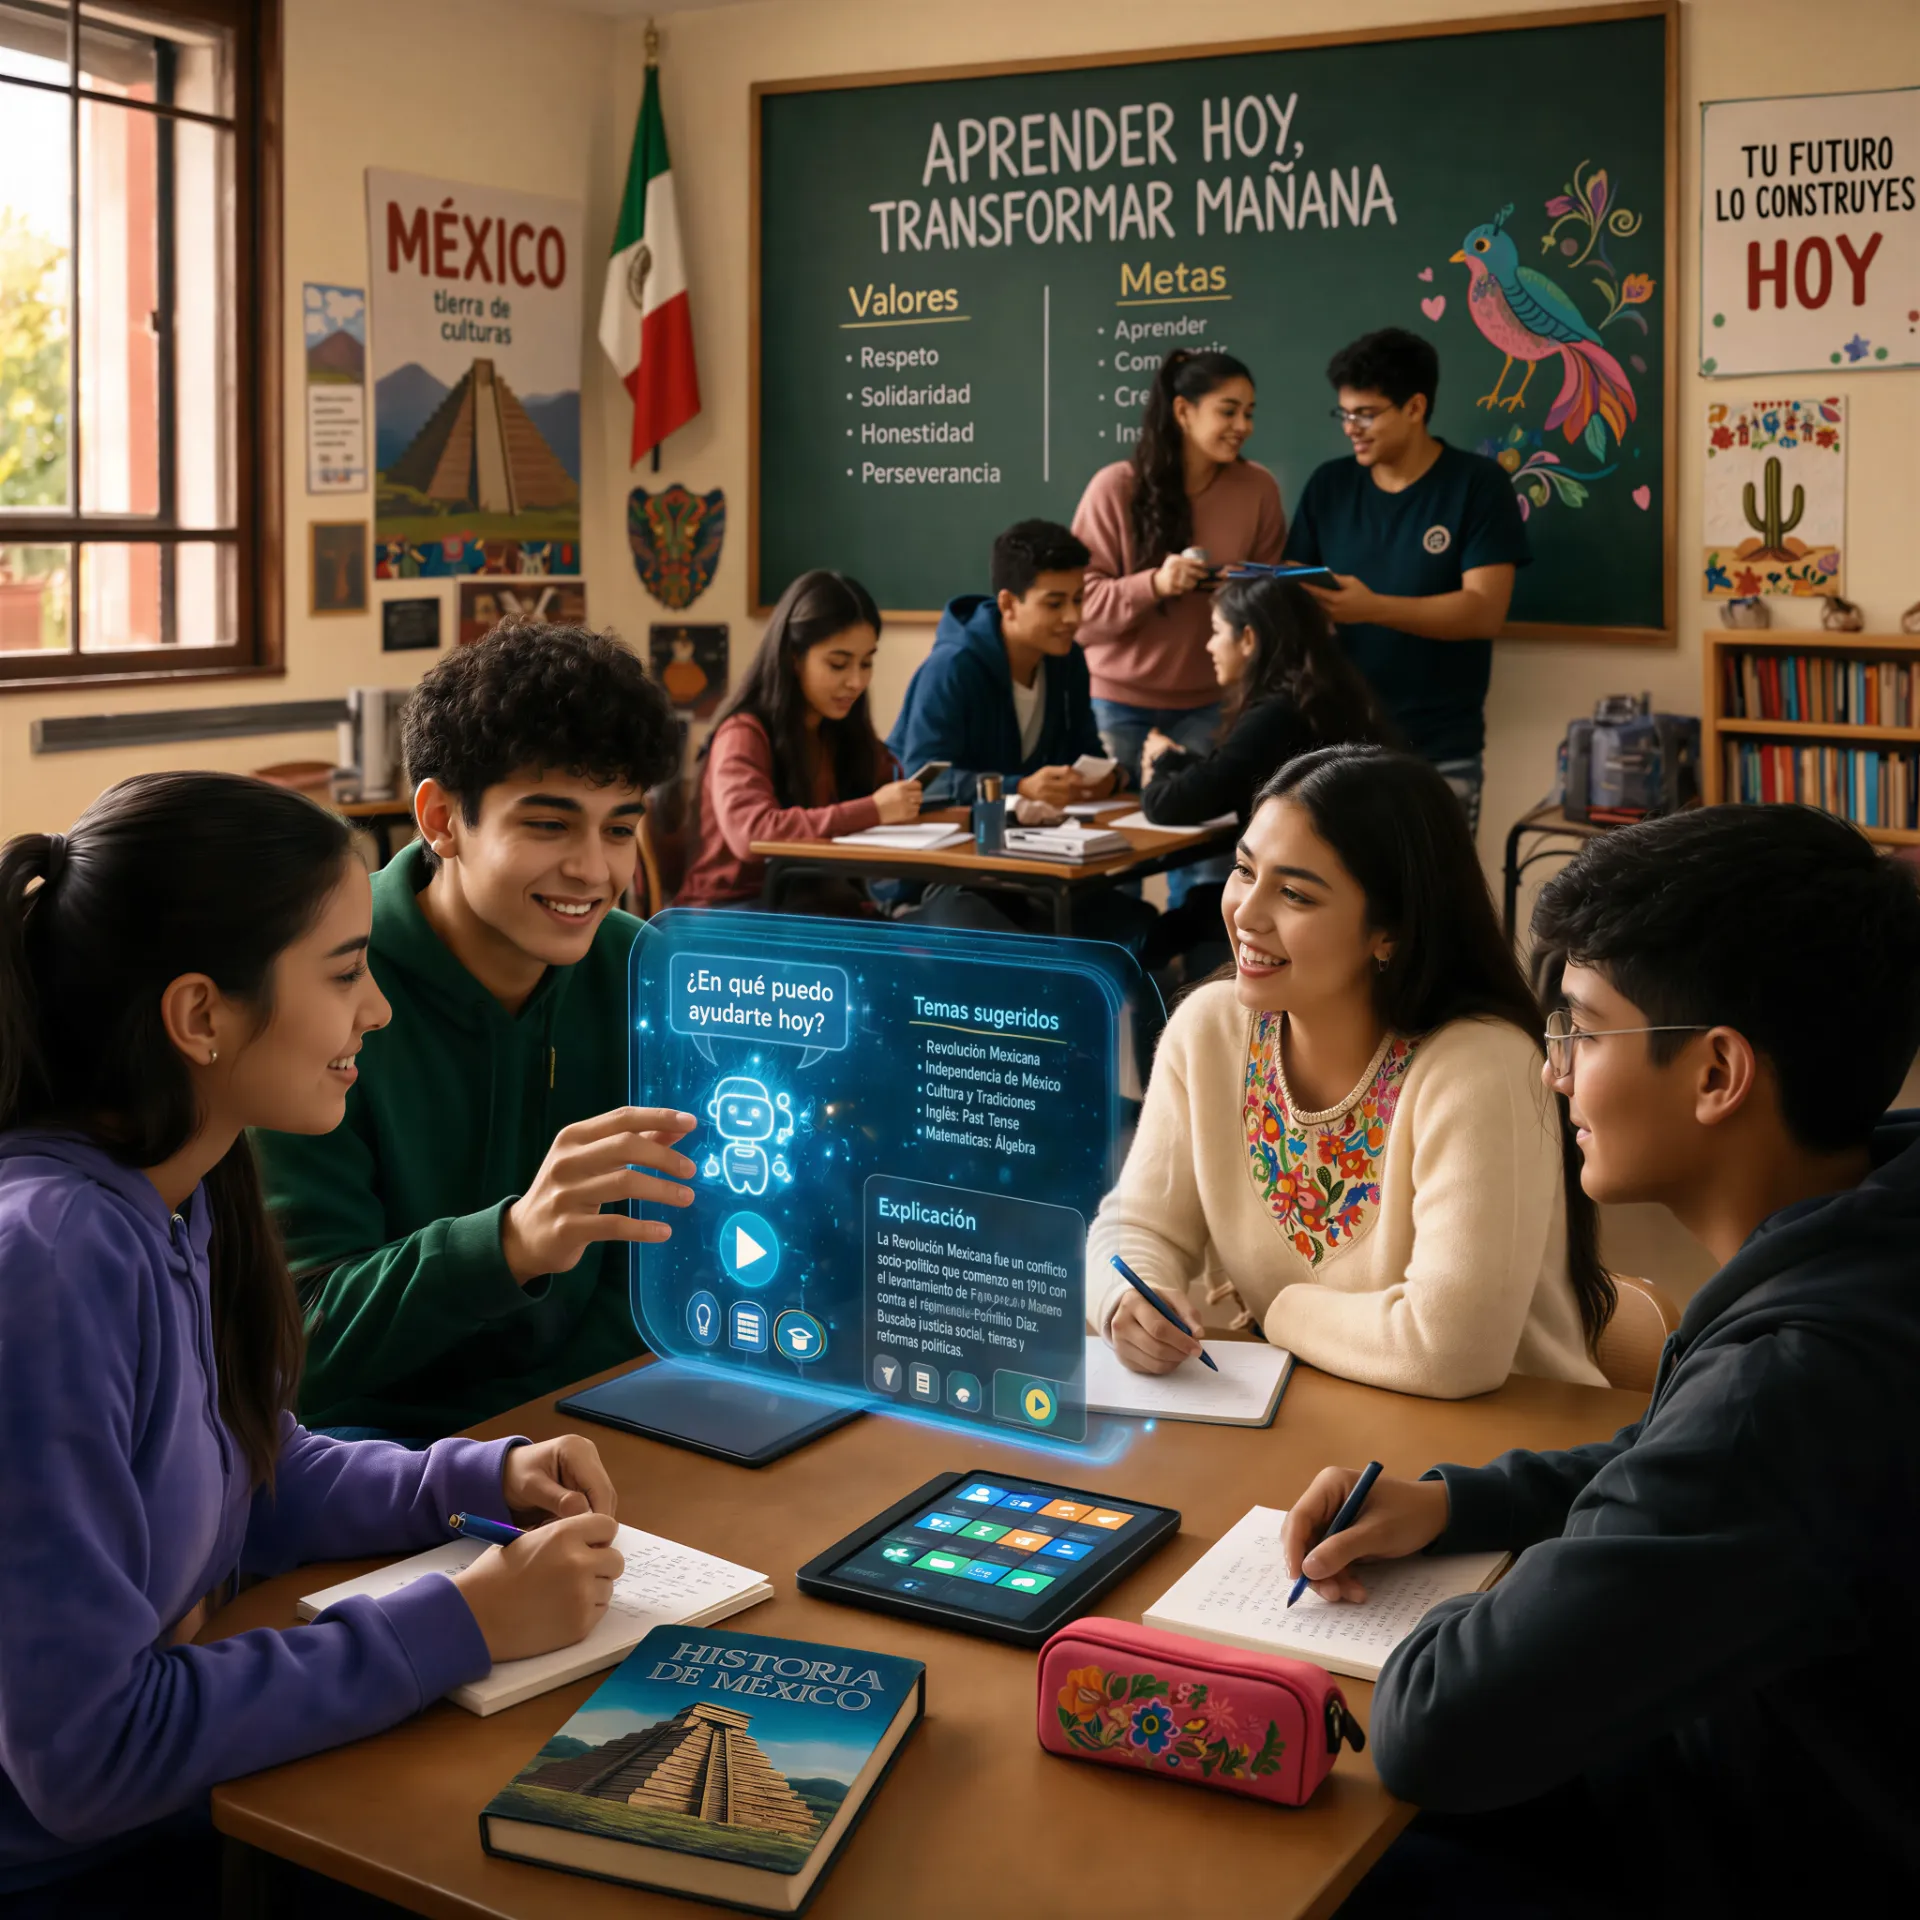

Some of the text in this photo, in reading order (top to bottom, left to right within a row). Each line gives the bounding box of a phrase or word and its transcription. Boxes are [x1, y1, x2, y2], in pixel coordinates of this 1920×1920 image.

[922, 92, 1305, 187] APRENDER HOY,
[1741, 136, 1893, 178] TU FUTURO
[868, 159, 1398, 254] TRANSFORMAR MAÑANA
[1716, 176, 1916, 222] LO CONSTRUYES
[386, 197, 566, 289] MÉXICO
[1120, 262, 1227, 296] Metas
[1747, 231, 1884, 311] HOY
[433, 289, 511, 320] tierra de
[848, 283, 959, 317] Valores
[441, 319, 512, 345] culturas
[1114, 315, 1208, 344] Aprender
[861, 346, 939, 374] Respeto
[861, 383, 971, 407] Solidaridad
[861, 420, 974, 445] Honestidad
[862, 460, 1001, 485] Perseverancia
[686, 970, 834, 1002] ¿En qué puedo
[689, 1002, 825, 1037] ayudarte hoy?
[914, 996, 1060, 1030] Temas sugeridos
[926, 1039, 1041, 1066] Revolución Mexicana
[925, 1060, 1061, 1092] Independencia de México
[926, 1083, 1036, 1111] Cultura y Tradiciones
[962, 1109, 984, 1126] Past
[988, 1113, 1020, 1130] Tense
[995, 1134, 1036, 1155] Álgebra
[879, 1197, 976, 1231] Explicación
[877, 1231, 889, 1246] La
[892, 1234, 944, 1256] Revolución
[947, 1243, 992, 1265] Mexicana
[993, 1251, 1010, 1268] fue
[1011, 1257, 1024, 1270] un
[877, 1271, 886, 1284] el
[888, 1272, 953, 1297] levantamiento
[955, 1285, 968, 1299] de
[942, 1266, 960, 1281] que
[1011, 1278, 1024, 1291] en
[1026, 1279, 1047, 1295] 1910
[1049, 1285, 1067, 1299] con
[877, 1291, 906, 1308] contra
[909, 1296, 917, 1309] el
[877, 1309, 1025, 1352] Buscaba justicia social, tierras y
[877, 1330, 918, 1349] reformas
[669, 1642, 885, 1692] HISTORIA
[646, 1661, 871, 1711] DE MÉXICO
